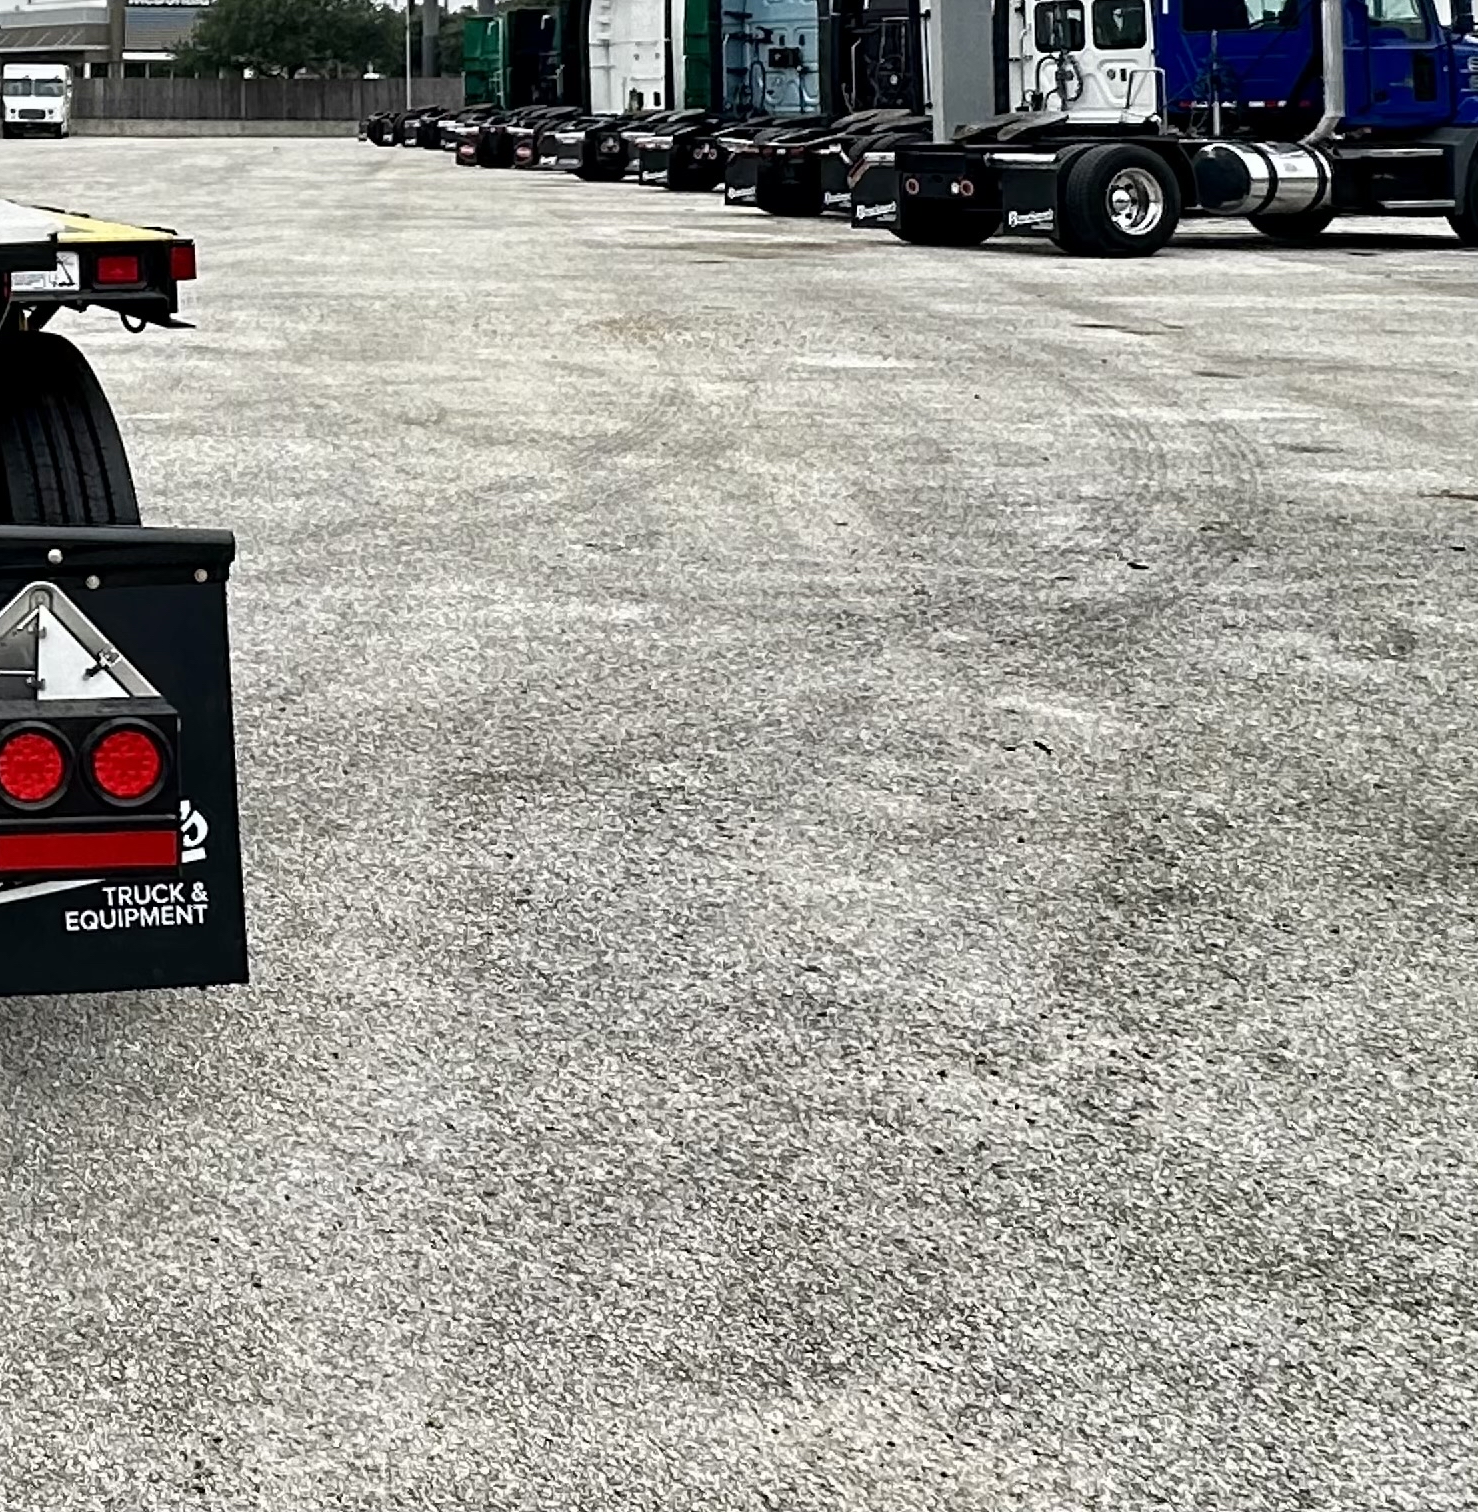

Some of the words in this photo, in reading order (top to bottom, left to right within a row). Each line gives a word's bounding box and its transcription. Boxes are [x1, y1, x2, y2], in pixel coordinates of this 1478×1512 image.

[102, 883, 185, 907] TRUCK
[191, 881, 209, 902] &
[65, 904, 208, 931] EQUIPMENT
